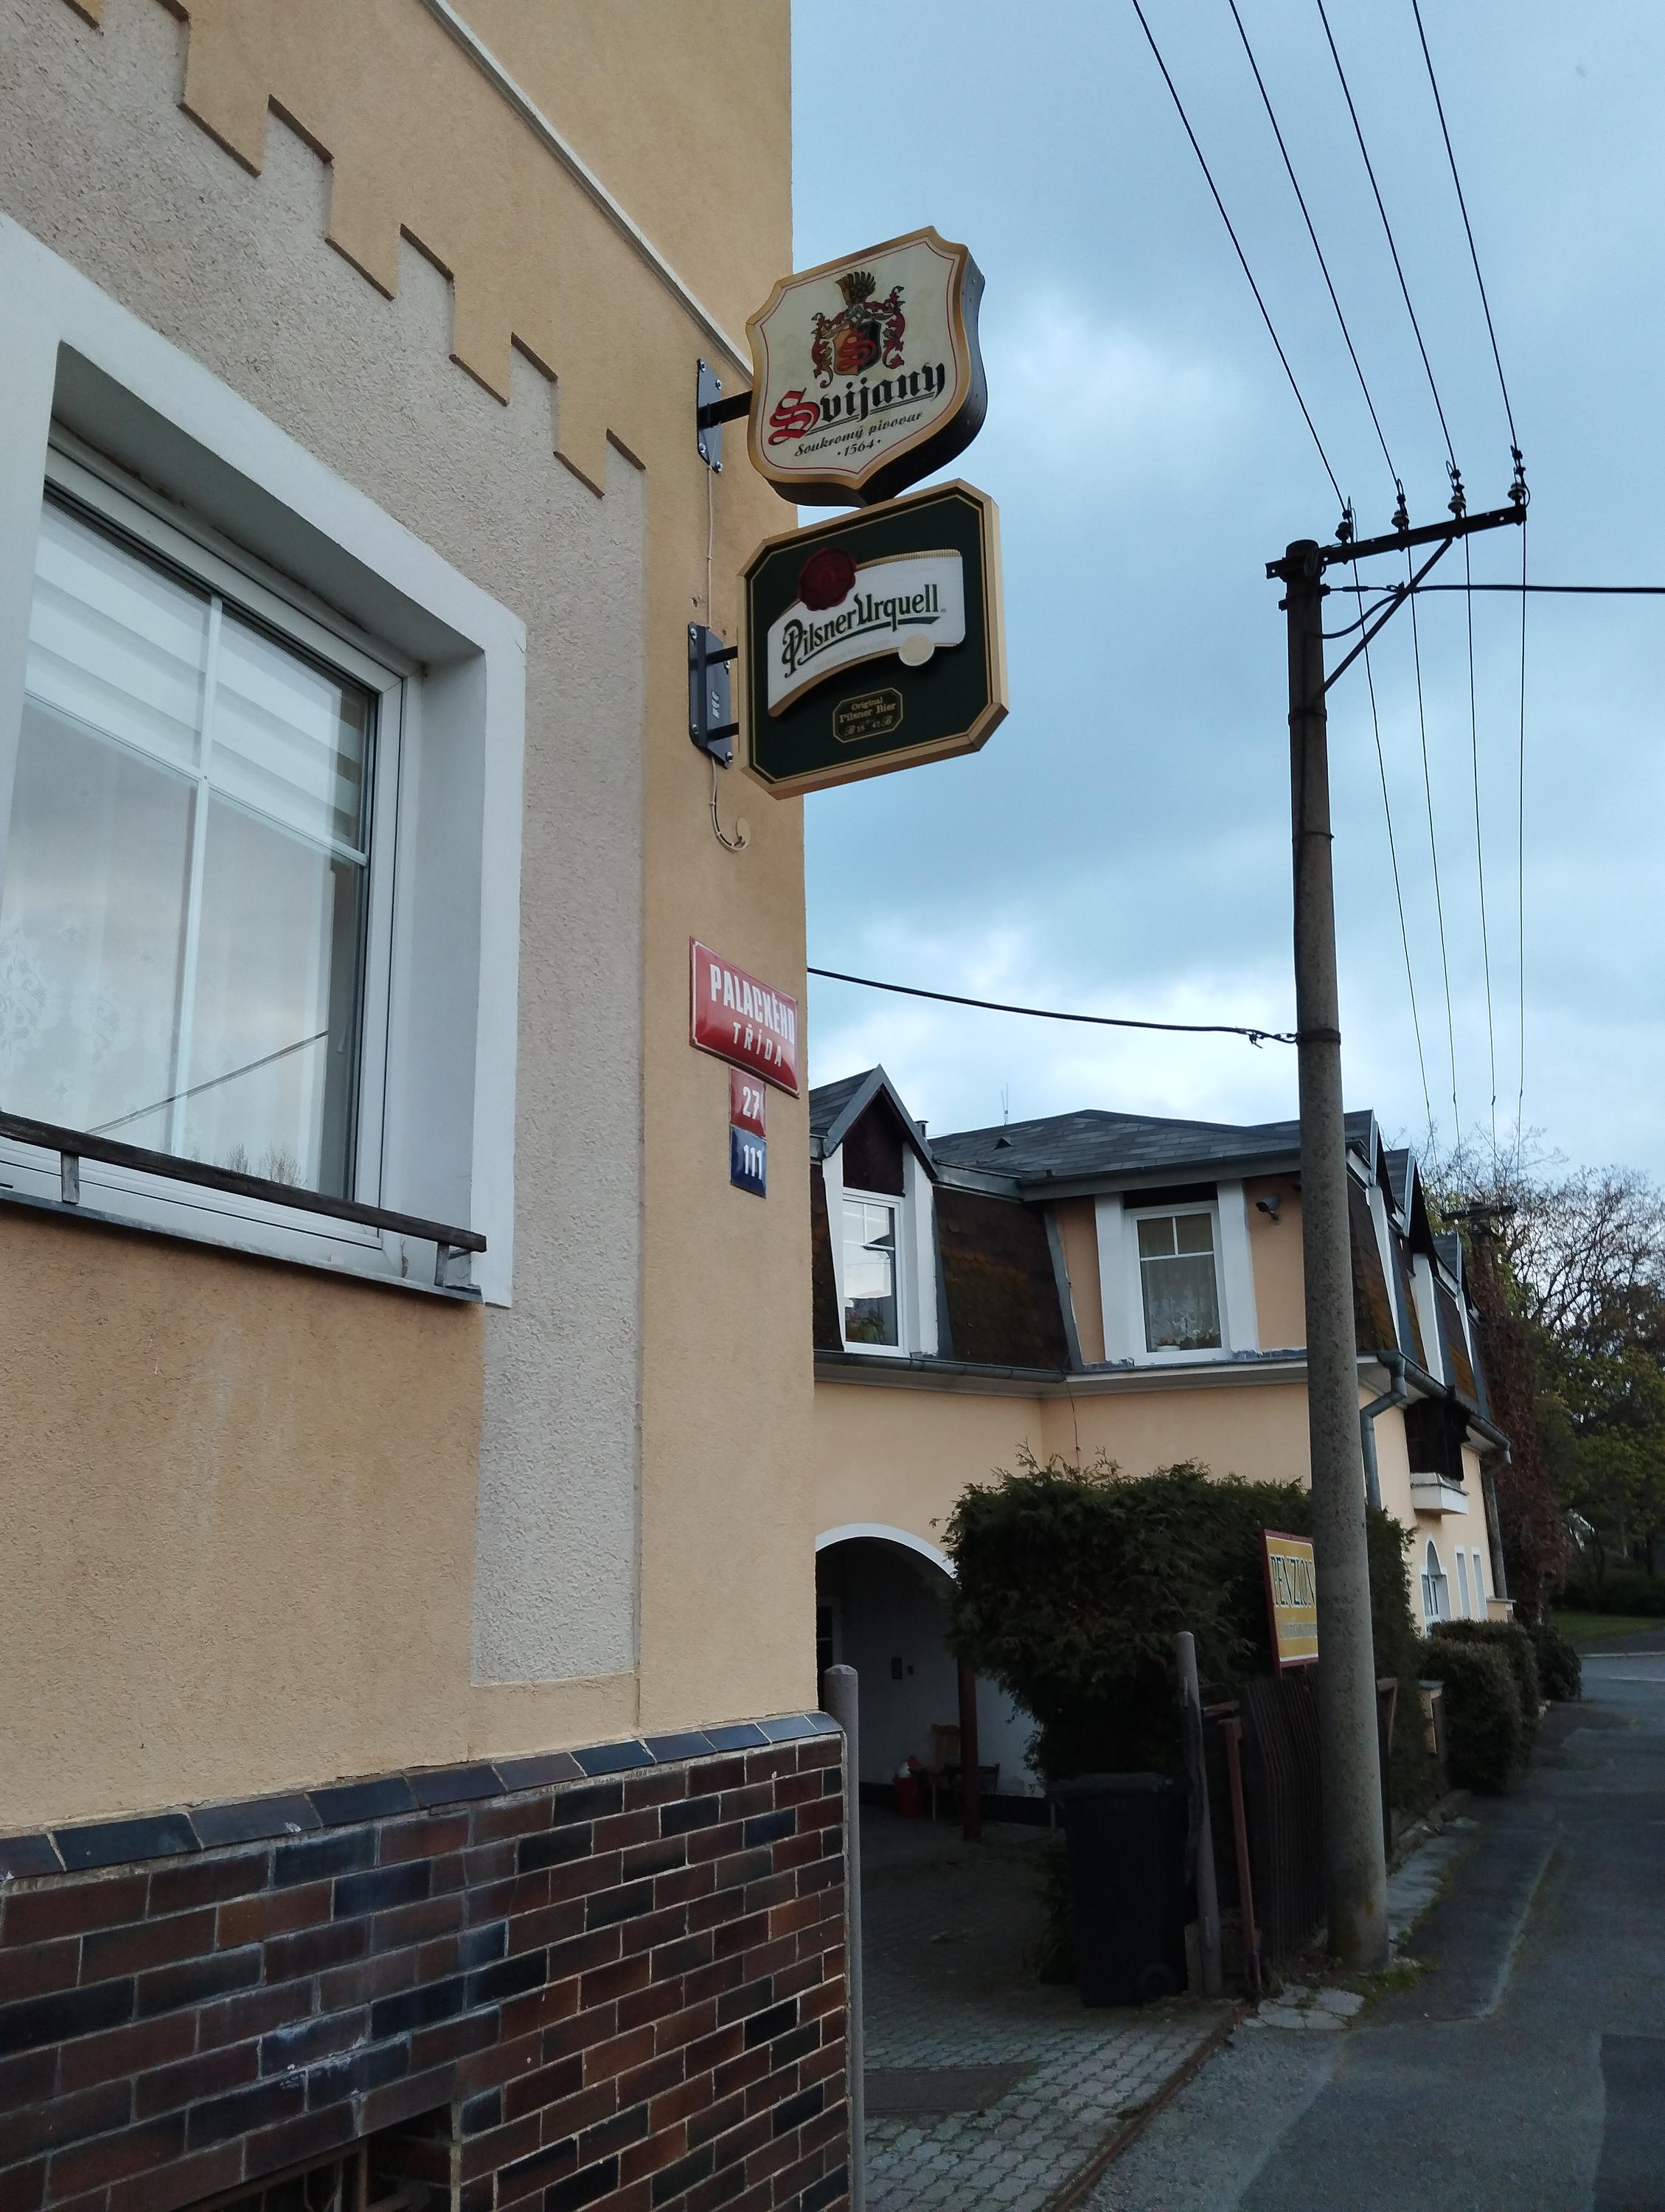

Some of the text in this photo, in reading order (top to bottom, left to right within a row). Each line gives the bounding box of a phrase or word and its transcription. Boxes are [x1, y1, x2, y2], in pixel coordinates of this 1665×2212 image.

[768, 362, 945, 446] Svijany
[794, 411, 923, 457] Soukromý pivovar
[781, 608, 856, 678] Pilsner
[853, 583, 939, 633] Urquell
[709, 963, 795, 1045] PALACKÉHO
[733, 1021, 782, 1068] TŘÍDA
[742, 1086, 759, 1119] 27
[743, 1144, 762, 1180] 111
[1270, 1554, 1315, 1607] PENZION
